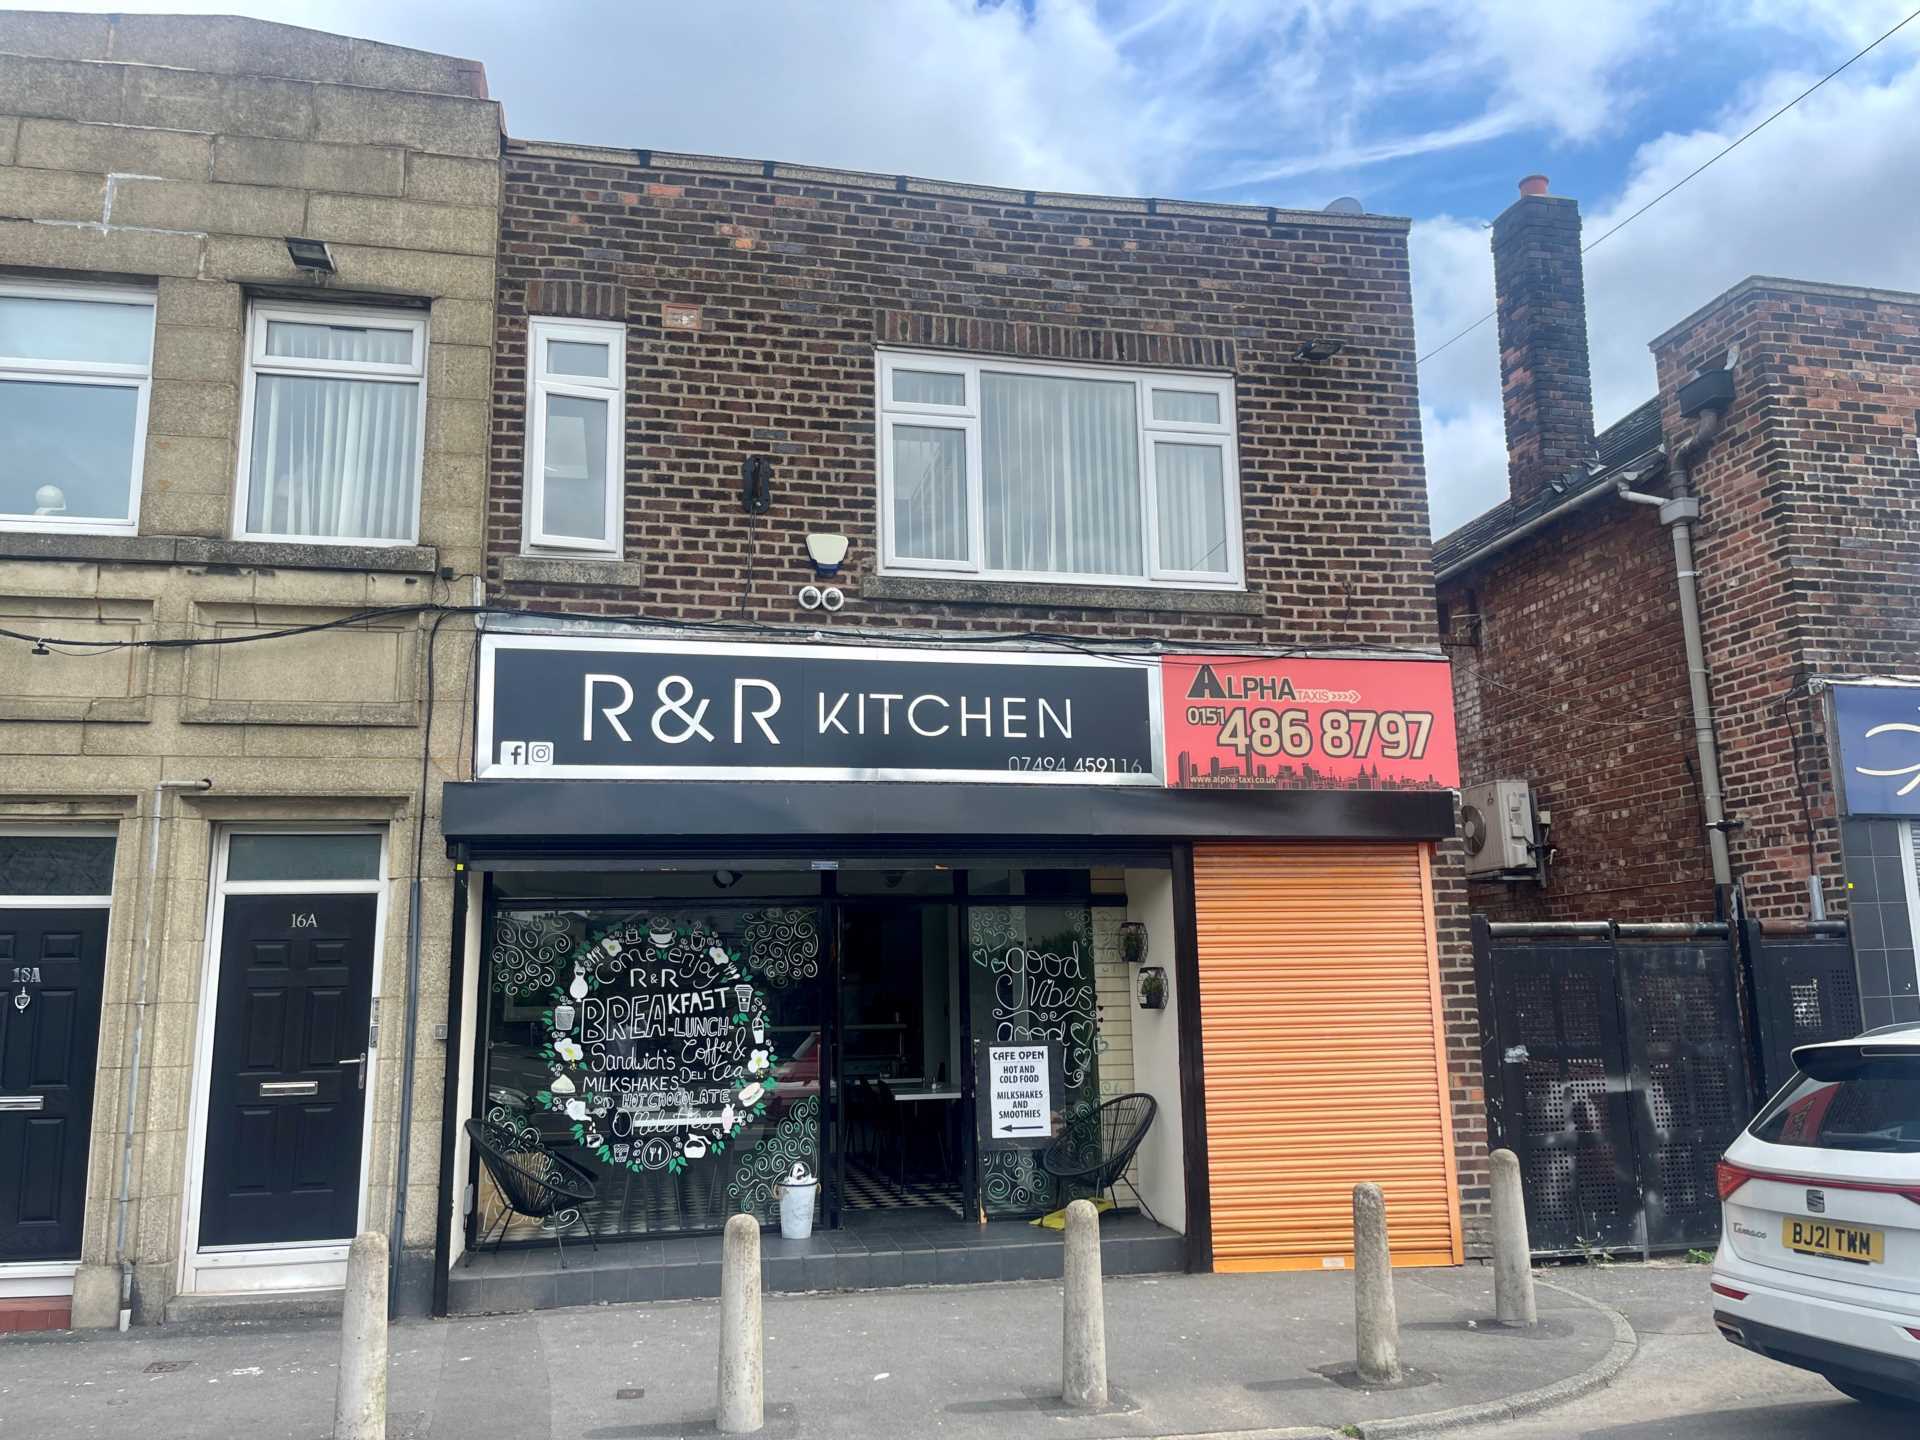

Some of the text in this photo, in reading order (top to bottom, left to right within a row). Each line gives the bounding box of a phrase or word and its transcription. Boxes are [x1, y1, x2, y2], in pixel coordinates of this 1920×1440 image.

[1186, 664, 1329, 703] ALPHA TAXIS
[818, 692, 1073, 739] KITCHEN
[1187, 706, 1433, 759] 0151 486 8797
[1008, 756, 1143, 773] 07494 459116
[291, 913, 318, 928] 16A
[595, 948, 657, 984] Come
[993, 1051, 1044, 1060] CAFE OPEN
[1003, 1065, 1035, 1074] HOT AND
[583, 1075, 679, 1093] MILKSHAKES
[1000, 1075, 1039, 1083] COLD FOOD
[621, 1088, 731, 1108] HOT CHOCOLATE
[997, 1090, 1043, 1099] MILKSHAKES
[1013, 1101, 1028, 1109] AND
[999, 1110, 1041, 1119] SMOOTHIES
[1792, 1222, 1830, 1249] BJ21
